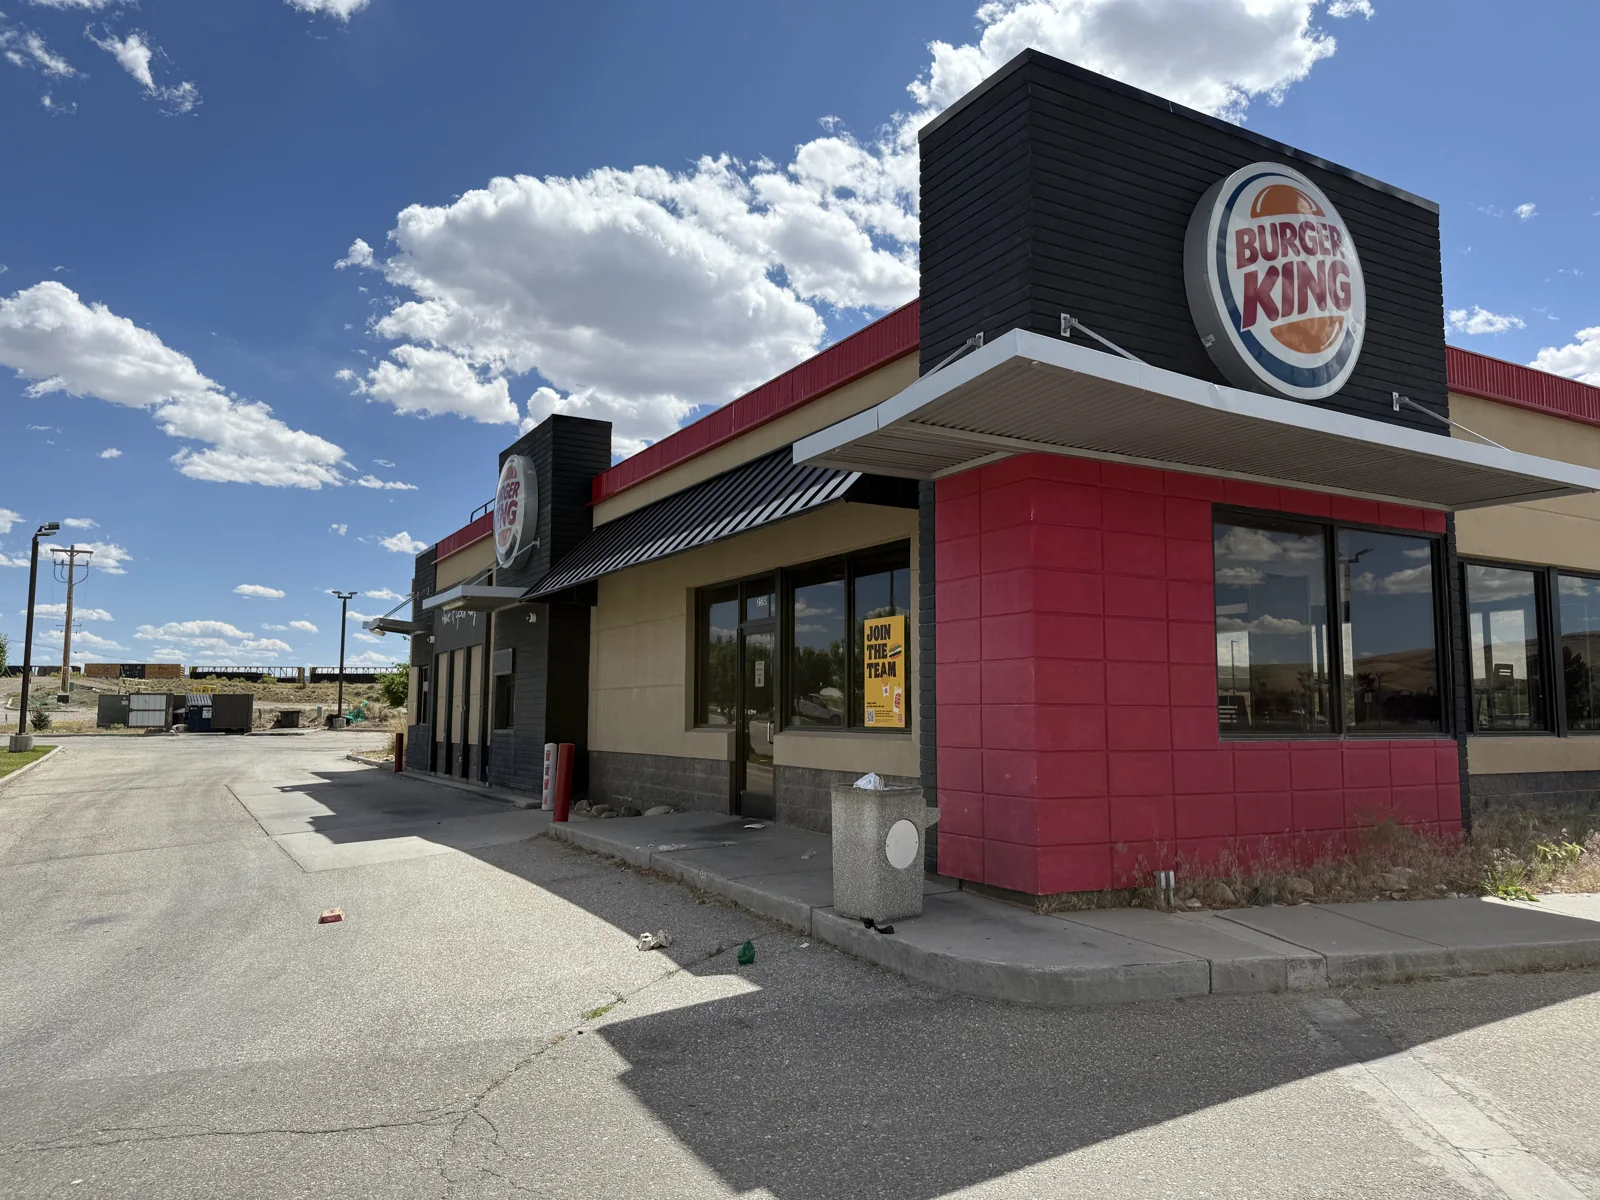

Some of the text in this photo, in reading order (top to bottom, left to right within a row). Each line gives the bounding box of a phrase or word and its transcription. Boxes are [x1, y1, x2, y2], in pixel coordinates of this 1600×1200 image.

[1235, 220, 1345, 270] BURGER
[1242, 260, 1351, 329] KING
[867, 623, 891, 642] JOIN
[867, 643, 888, 660] THE
[867, 661, 896, 679] TEAM
